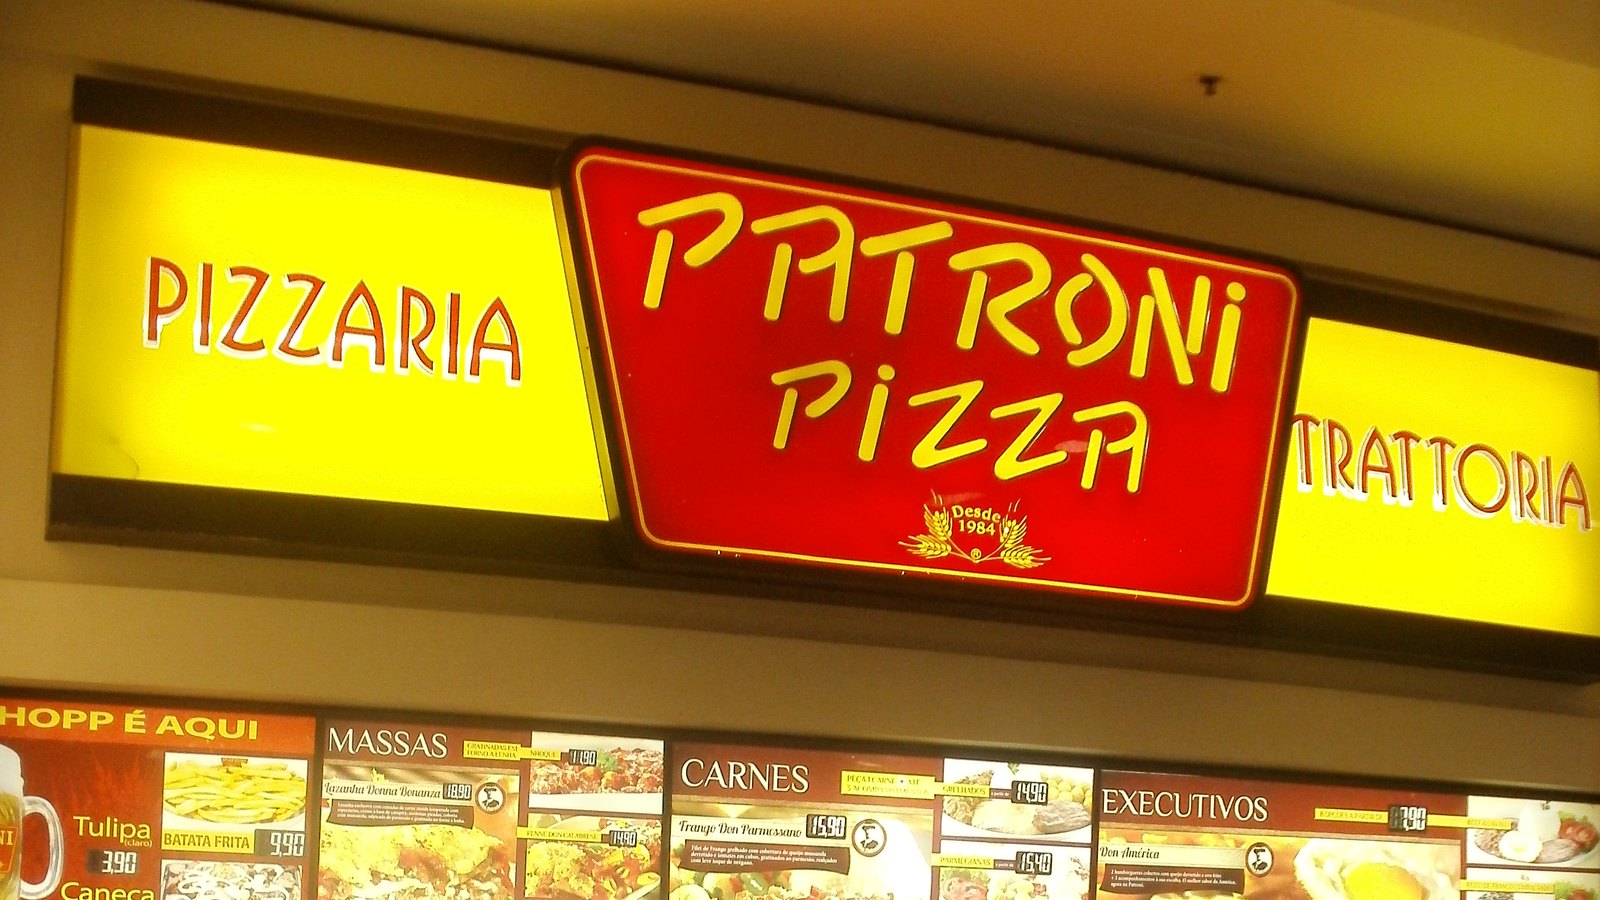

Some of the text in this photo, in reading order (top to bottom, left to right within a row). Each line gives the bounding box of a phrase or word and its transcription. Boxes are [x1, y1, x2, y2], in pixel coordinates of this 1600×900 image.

[145, 256, 523, 384] PIZZARIA
[1292, 412, 1593, 532] TRATTORIA
[951, 504, 1001, 523] Desde
[958, 519, 996, 536] 1984
[124, 709, 147, 734] É
[155, 715, 259, 740] AQUI
[328, 727, 448, 759] MASSAS
[680, 758, 810, 794] CARNES
[1101, 788, 1269, 822] EXECUTIVOS
[73, 815, 151, 843] Tulipa
[163, 832, 250, 849] BATATA FRITA
[124, 838, 153, 848] (claro)
[270, 831, 306, 857] 9,90
[1099, 845, 1160, 859] Don América
[101, 850, 137, 875] 3,90
[60, 881, 155, 900] Caneca
